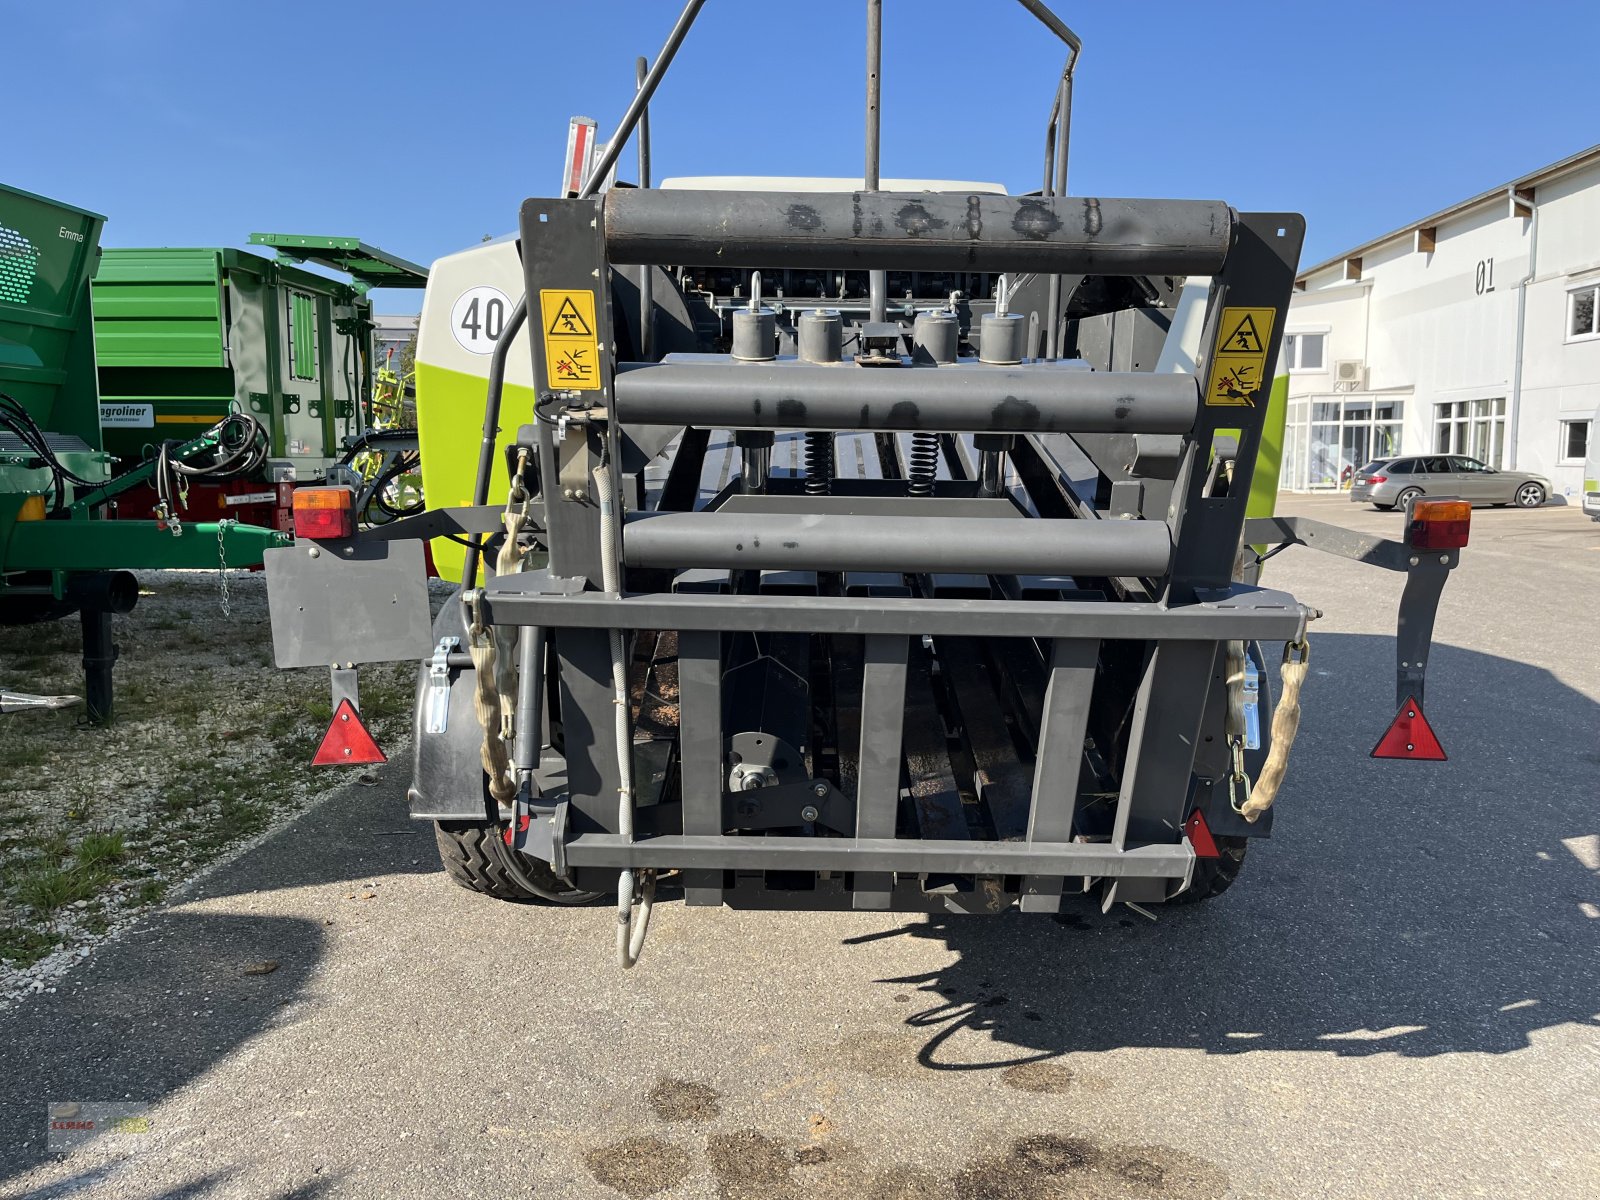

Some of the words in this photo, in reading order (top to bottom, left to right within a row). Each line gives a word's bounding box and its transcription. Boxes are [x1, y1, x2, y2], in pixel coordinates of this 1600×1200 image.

[59, 226, 84, 243] Emma
[1475, 256, 1496, 296] 01
[461, 297, 504, 341] 40
[100, 405, 147, 418] agroliner
